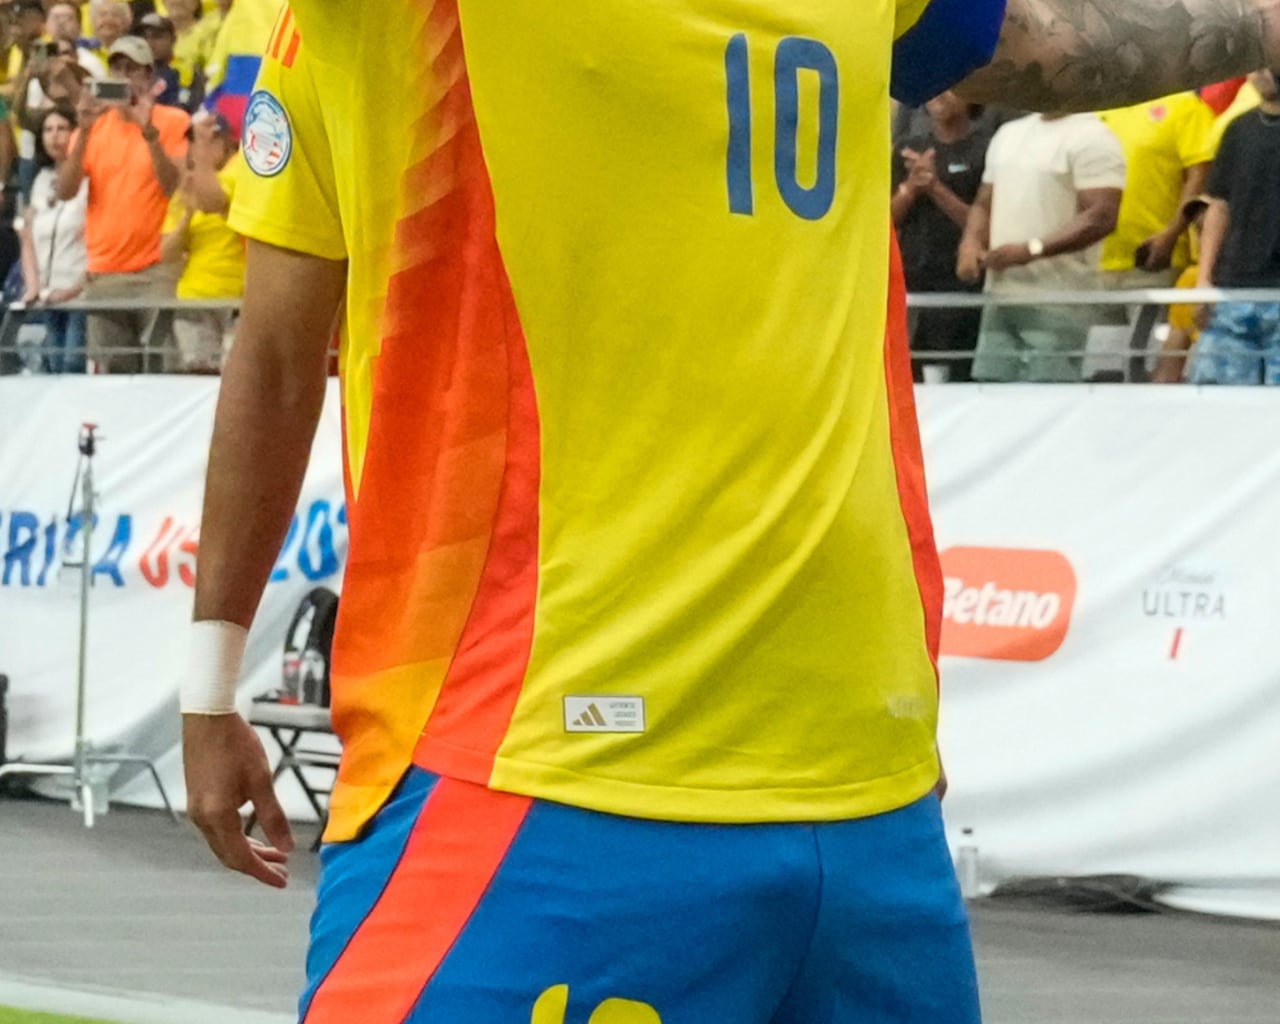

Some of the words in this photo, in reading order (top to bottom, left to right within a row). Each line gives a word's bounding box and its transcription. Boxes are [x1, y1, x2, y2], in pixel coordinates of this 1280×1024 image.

[724, 31, 839, 221] 10
[943, 576, 1061, 630] Betano
[1142, 588, 1226, 619] ULTRA
